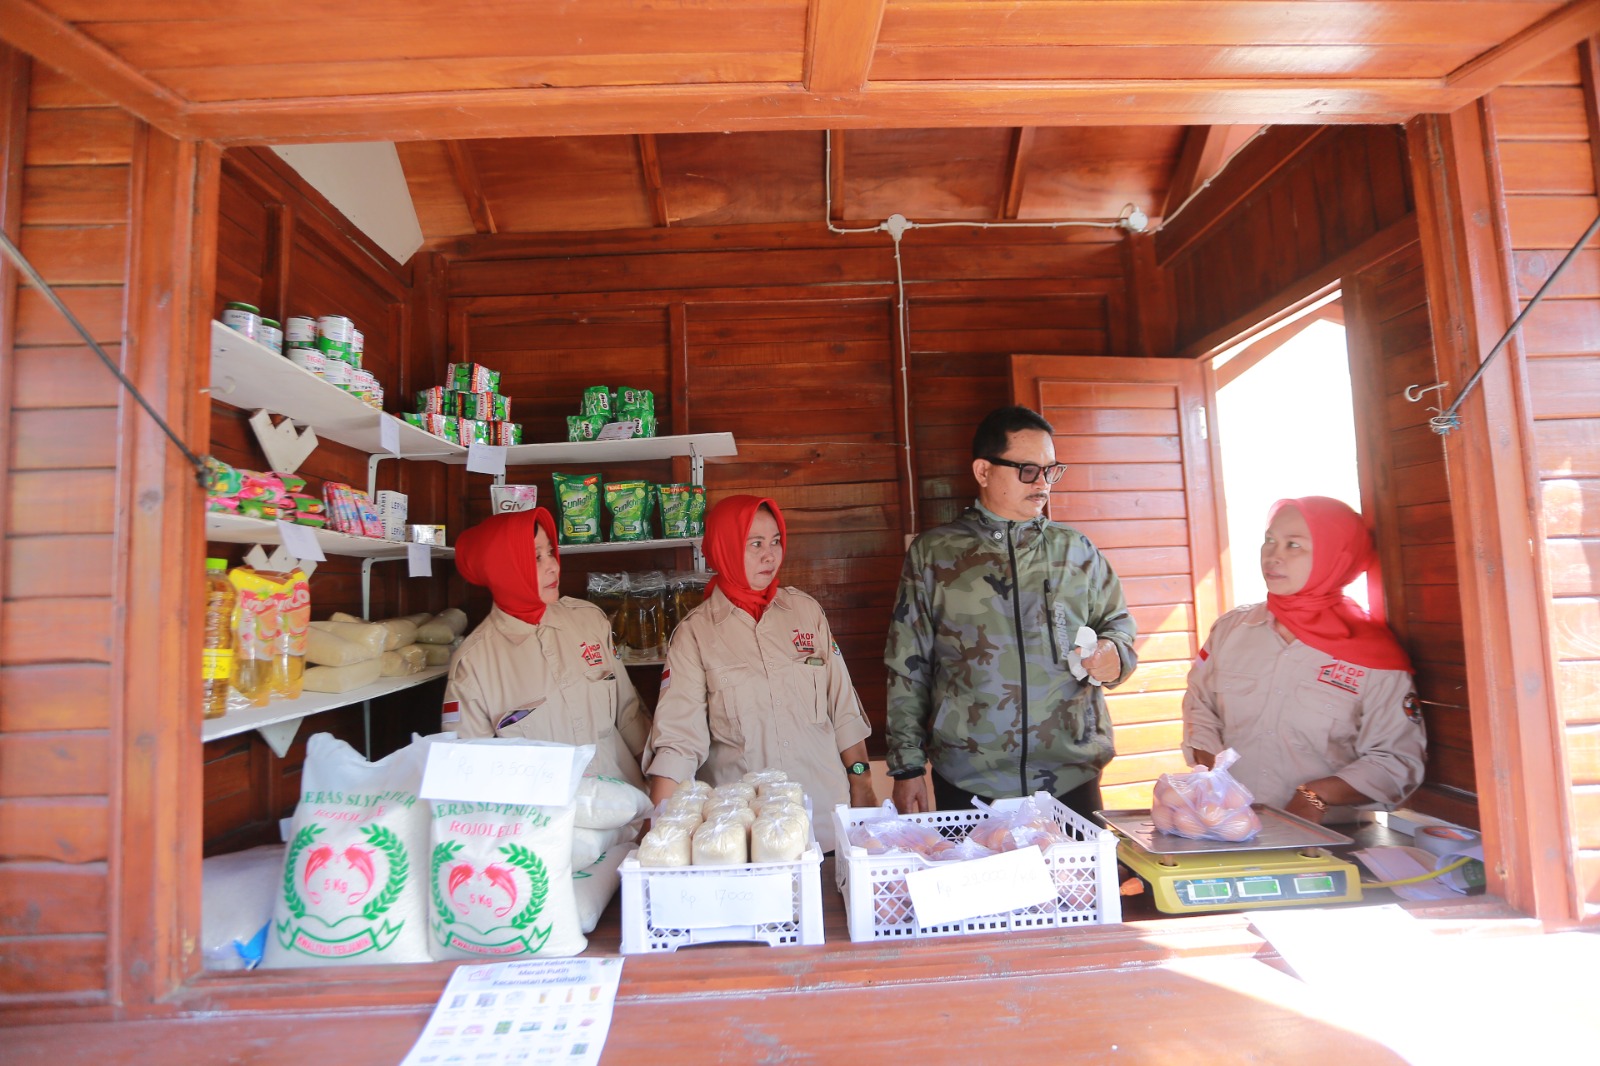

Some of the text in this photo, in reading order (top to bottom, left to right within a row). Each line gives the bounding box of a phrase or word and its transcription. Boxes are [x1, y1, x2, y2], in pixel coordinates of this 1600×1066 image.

[500, 500, 525, 511] Giv
[561, 494, 592, 515] Sunlight
[1338, 665, 1365, 677] KOP
[1334, 674, 1360, 687] KEL
[449, 820, 523, 838] ROJOLELE
[323, 878, 348, 894] 5 Kg
[470, 893, 493, 908] 5 Kg
[680, 889, 696, 909] Rp
